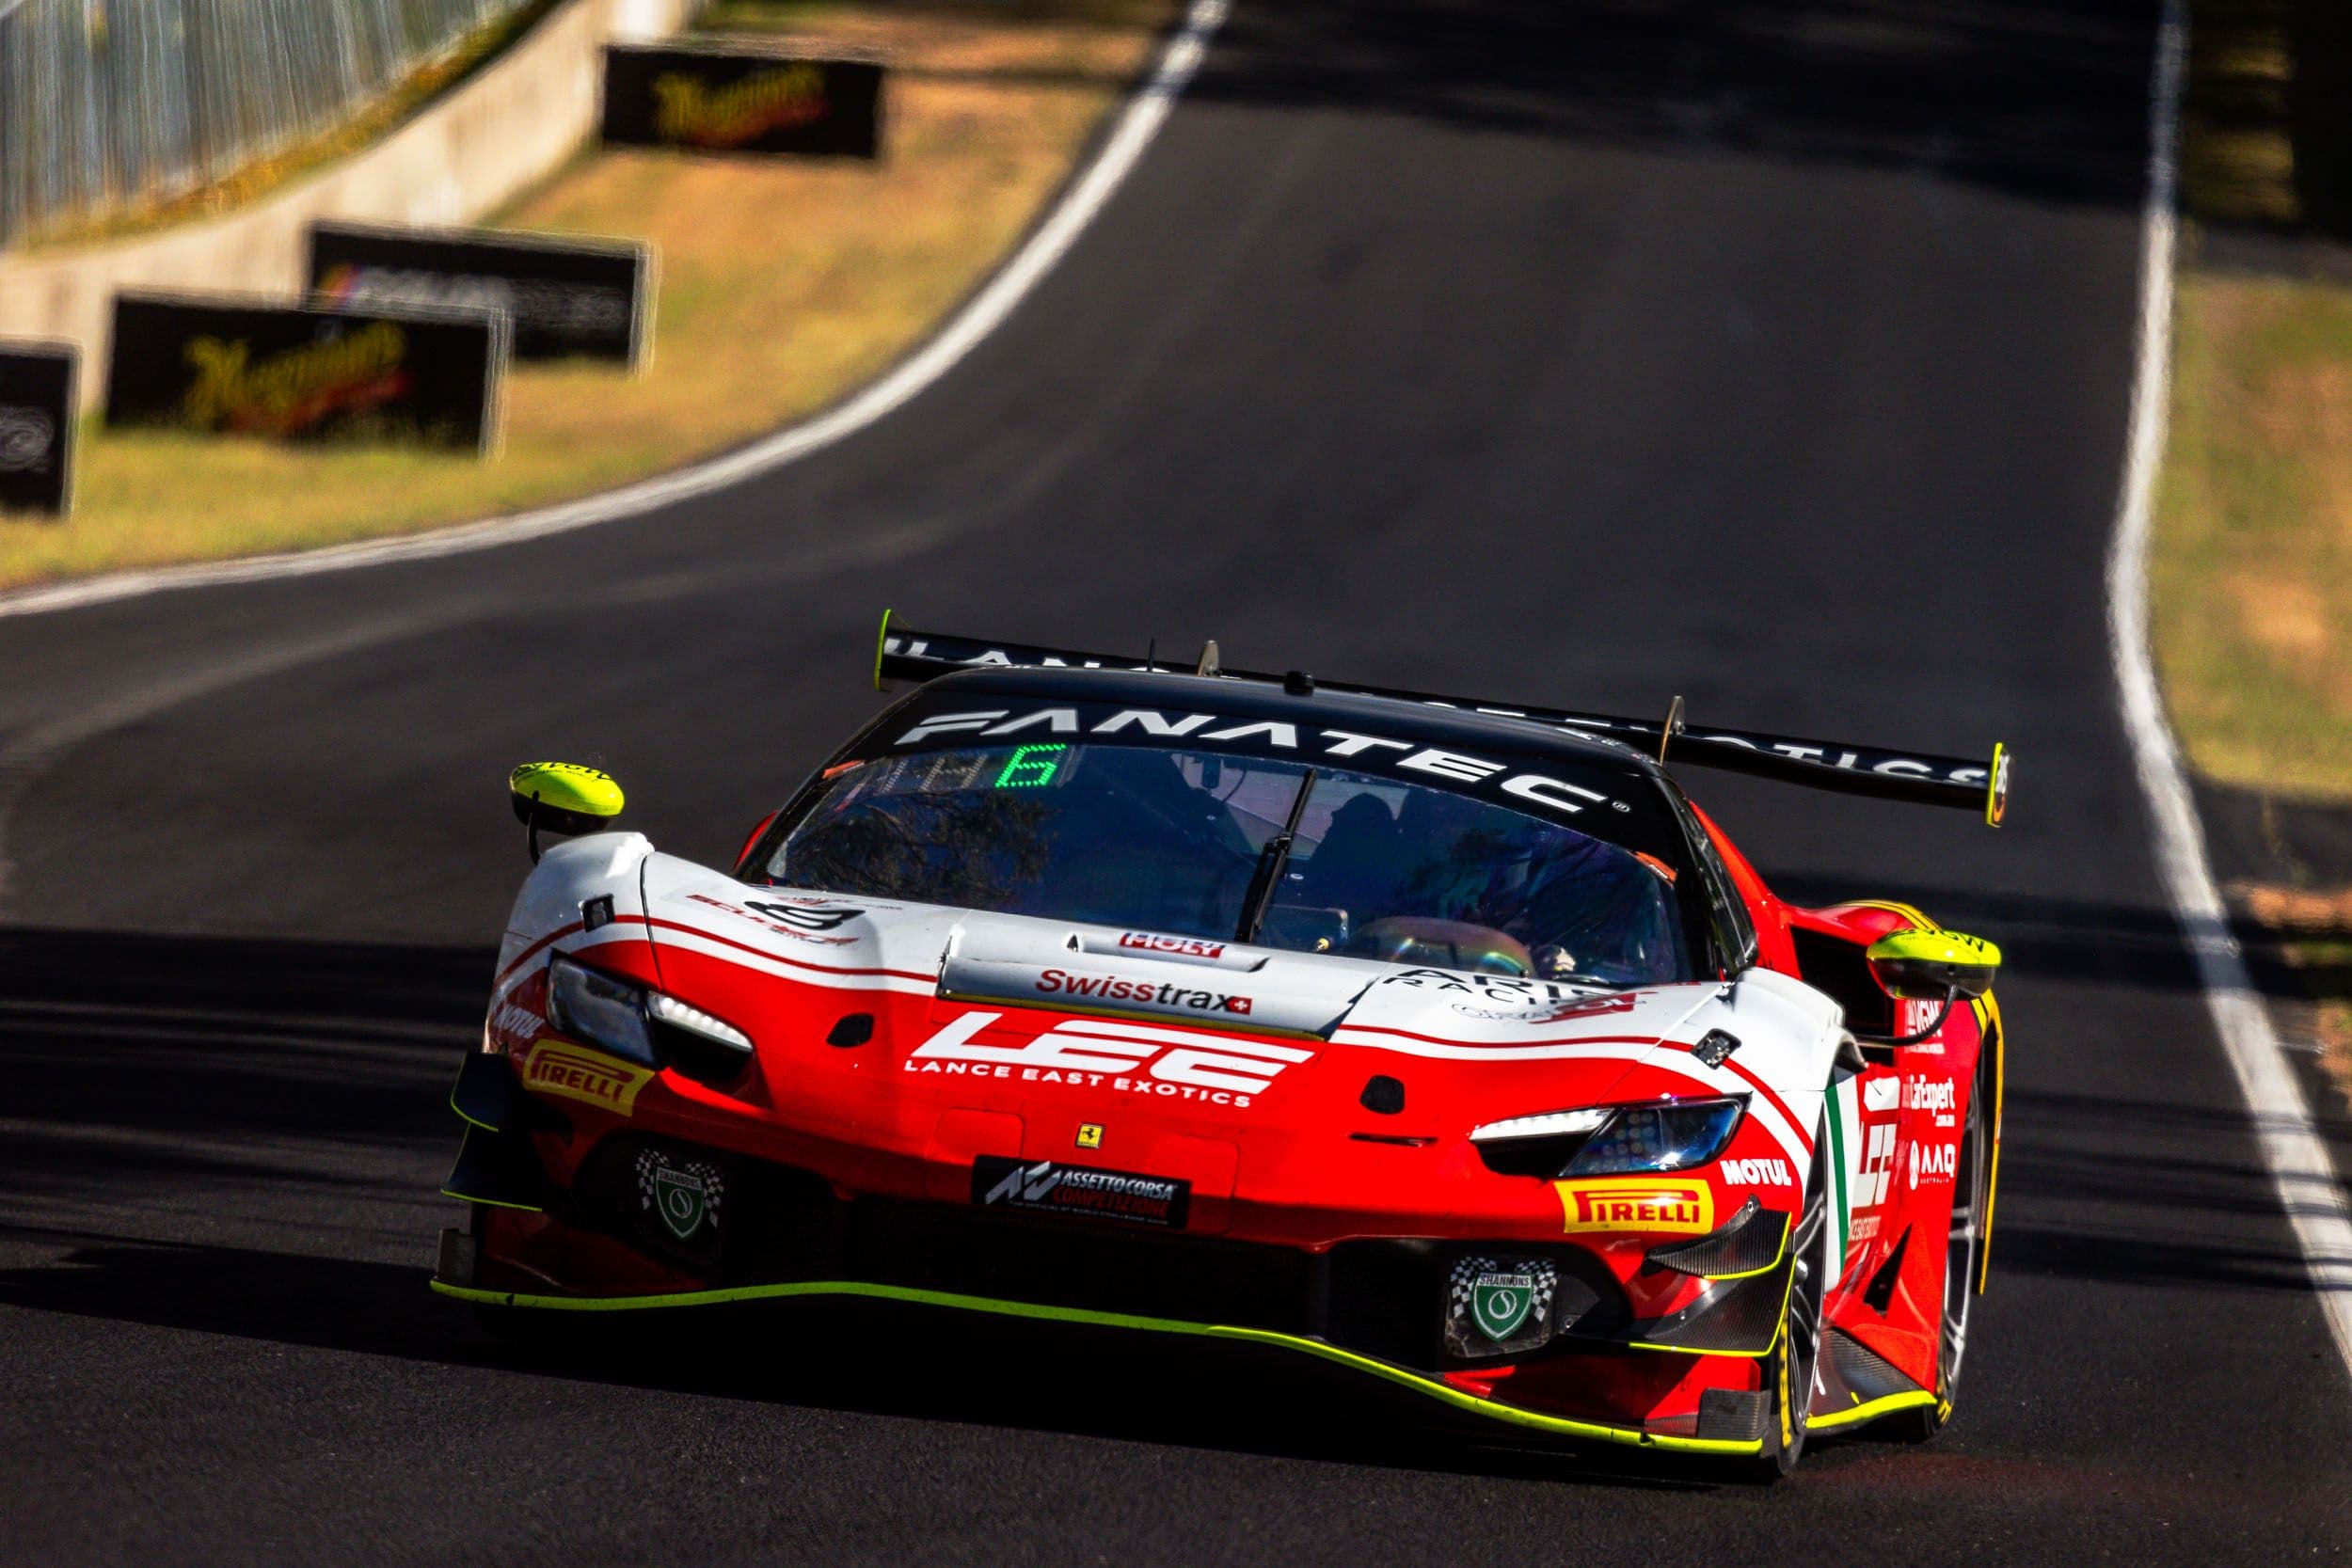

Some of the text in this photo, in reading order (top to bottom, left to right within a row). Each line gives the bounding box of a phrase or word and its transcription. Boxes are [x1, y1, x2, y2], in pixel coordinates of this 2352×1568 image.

[894, 708, 1608, 813] FANATEC
[994, 743, 1066, 788] 6
[1123, 933, 1224, 957] MOLY
[1036, 969, 1233, 1013] Swisstrax
[911, 1010, 1315, 1095] LEE
[529, 1048, 635, 1102] PIRELLI
[904, 1059, 1250, 1108] LANCE EAST EXOTICS
[1060, 1169, 1175, 1201] ASSETTO CORSA
[1719, 1158, 1792, 1186] MOTUL
[1572, 1189, 1700, 1223] PIRELLI
[1479, 1273, 1530, 1288] SHANNONS
